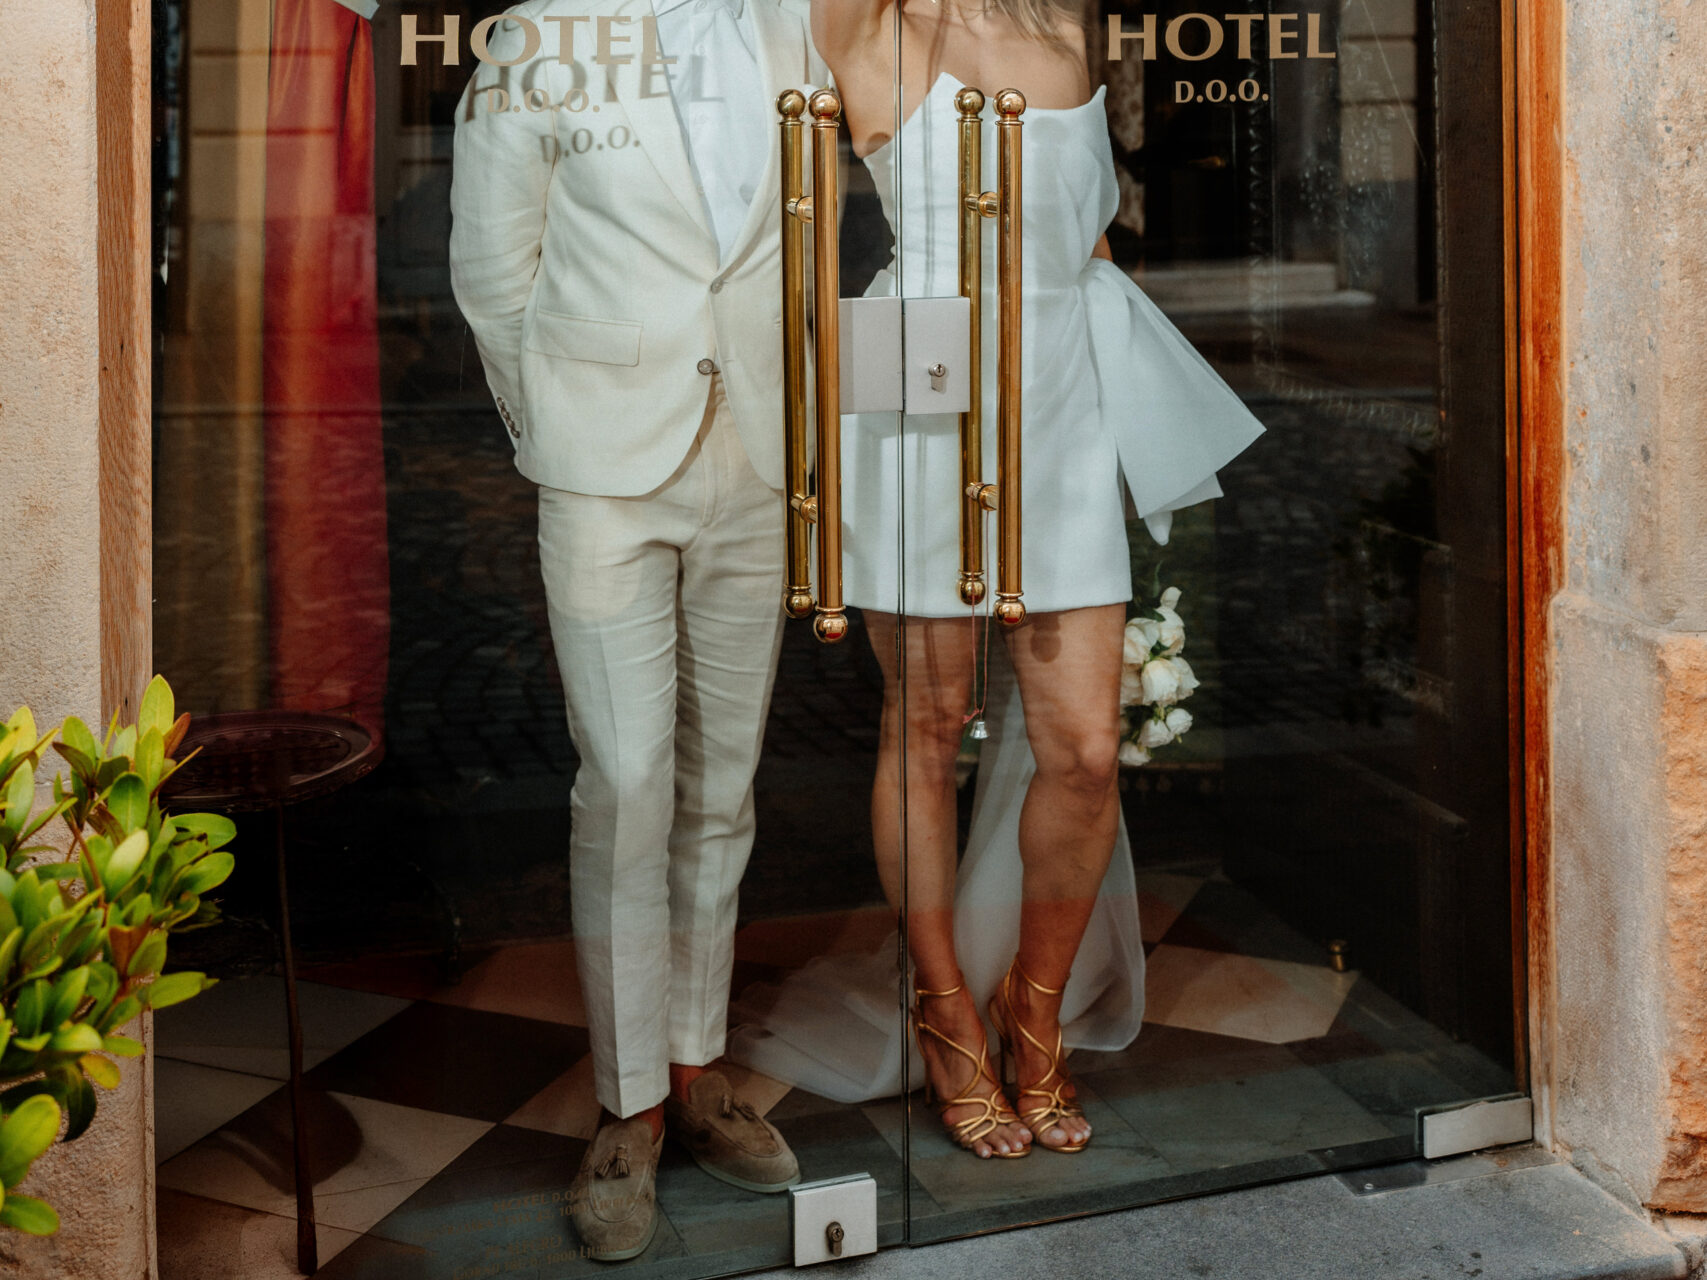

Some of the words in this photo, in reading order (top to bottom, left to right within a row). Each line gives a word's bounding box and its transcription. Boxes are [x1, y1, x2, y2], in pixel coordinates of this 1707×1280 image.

[400, 14, 679, 67] HOTEL
[1107, 13, 1337, 61] HOTEL
[486, 88, 601, 114] D.O.O.
[1175, 78, 1270, 104] D.O.O.
